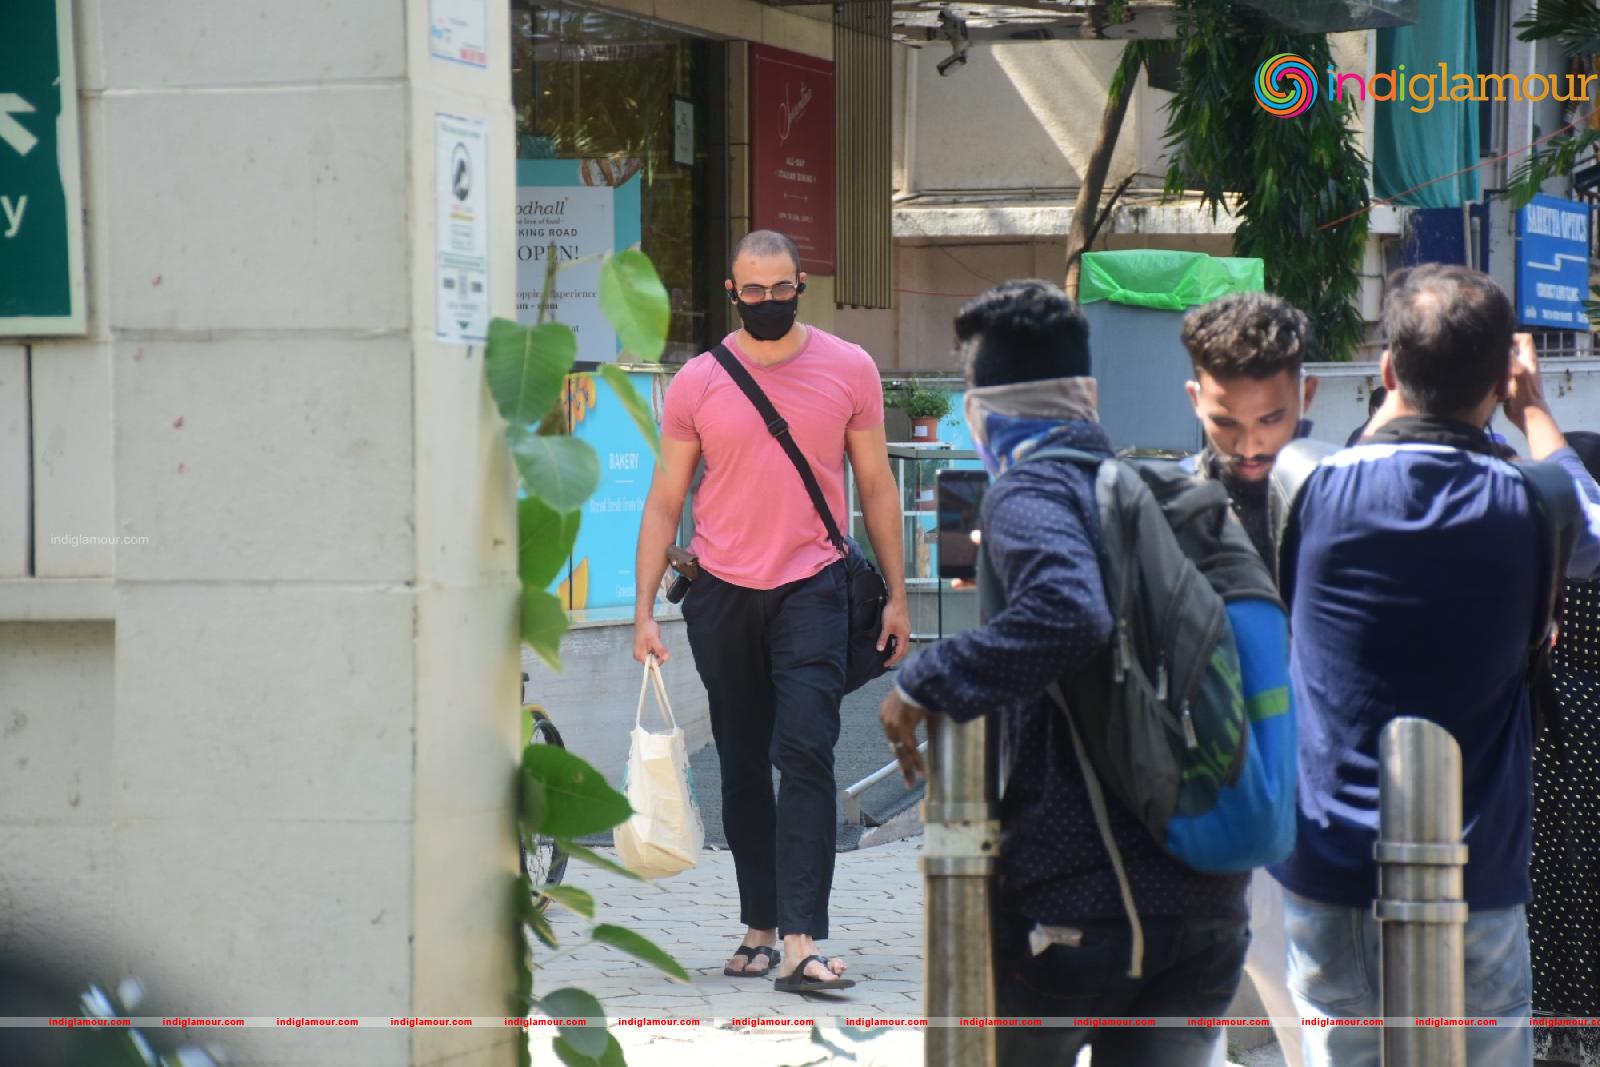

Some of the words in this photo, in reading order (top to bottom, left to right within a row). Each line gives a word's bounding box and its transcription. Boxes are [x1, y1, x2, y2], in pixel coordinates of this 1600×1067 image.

[0, 195, 28, 238] y
[518, 228, 545, 237] KING
[549, 228, 578, 237] ROAD
[608, 452, 640, 470] BAKERY
